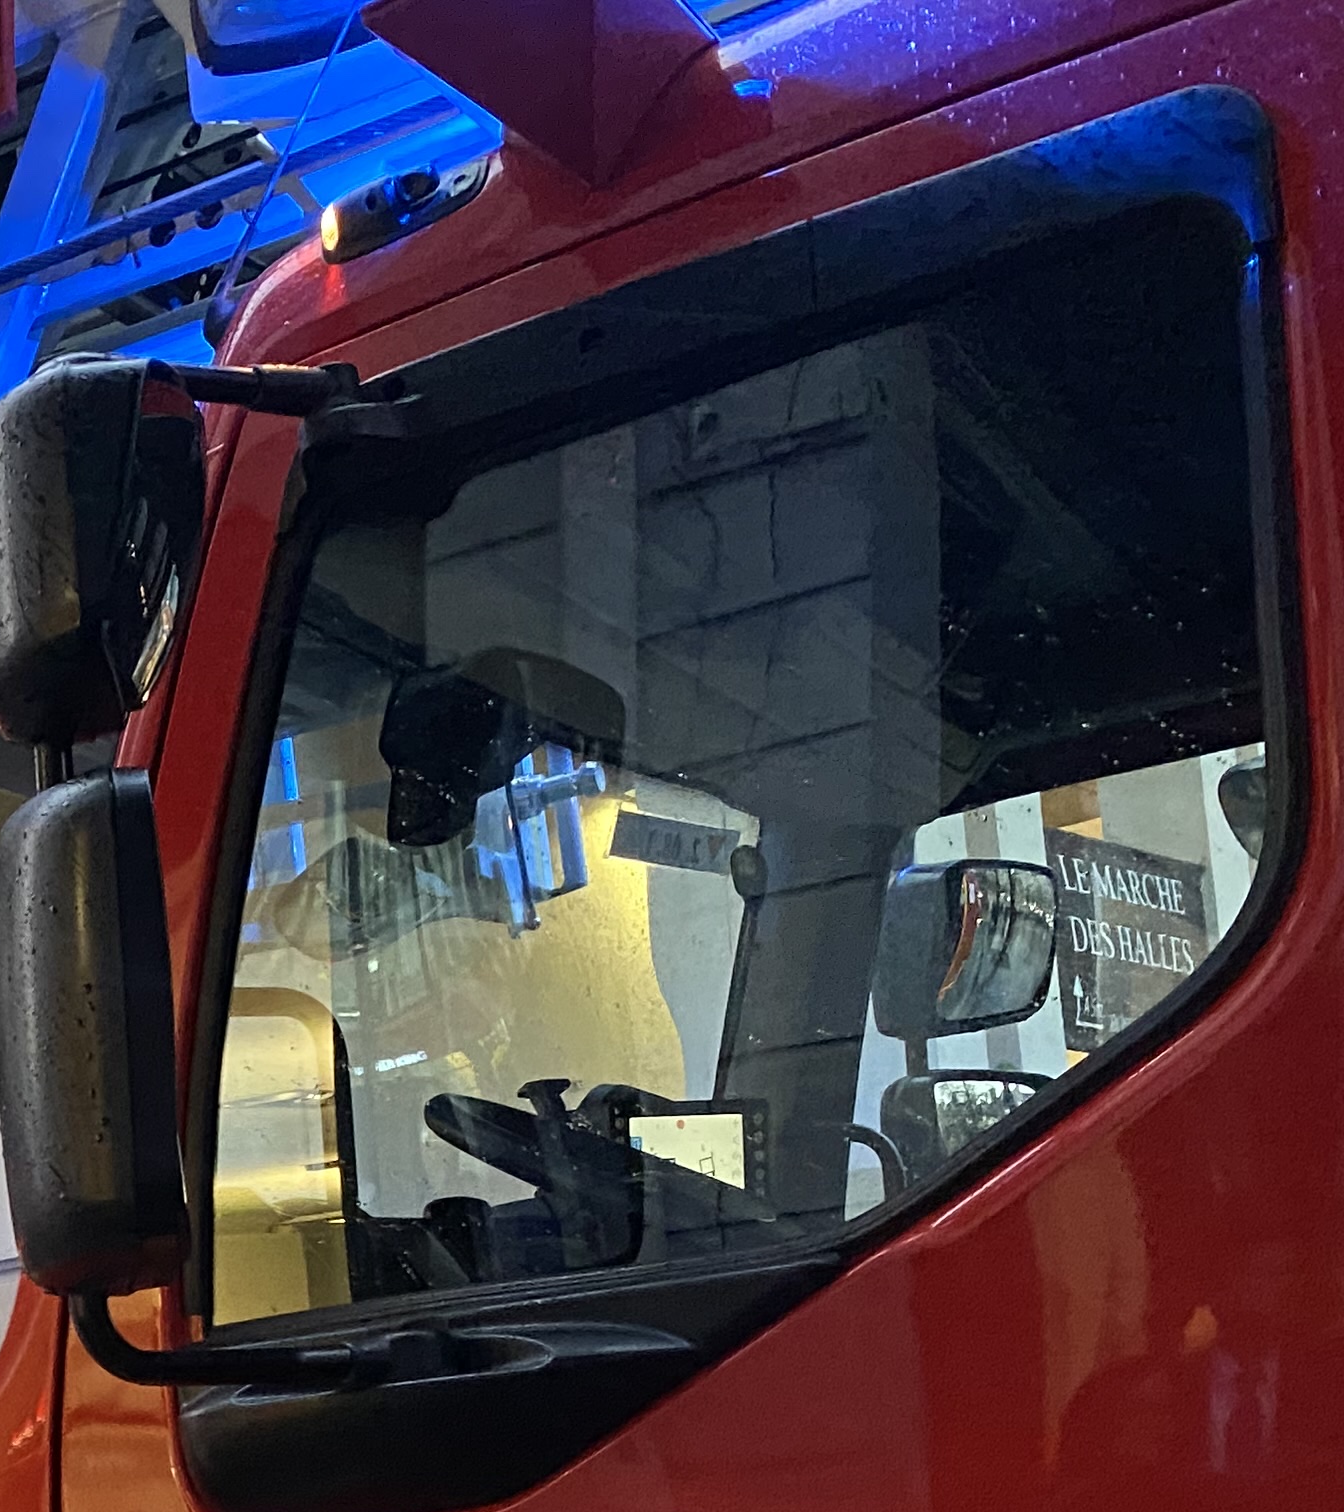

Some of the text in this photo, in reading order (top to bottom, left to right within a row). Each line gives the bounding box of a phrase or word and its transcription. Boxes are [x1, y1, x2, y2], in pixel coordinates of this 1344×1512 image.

[1056, 854, 1186, 915] LE MARCHE
[1069, 915, 1196, 976] DES HALLES
